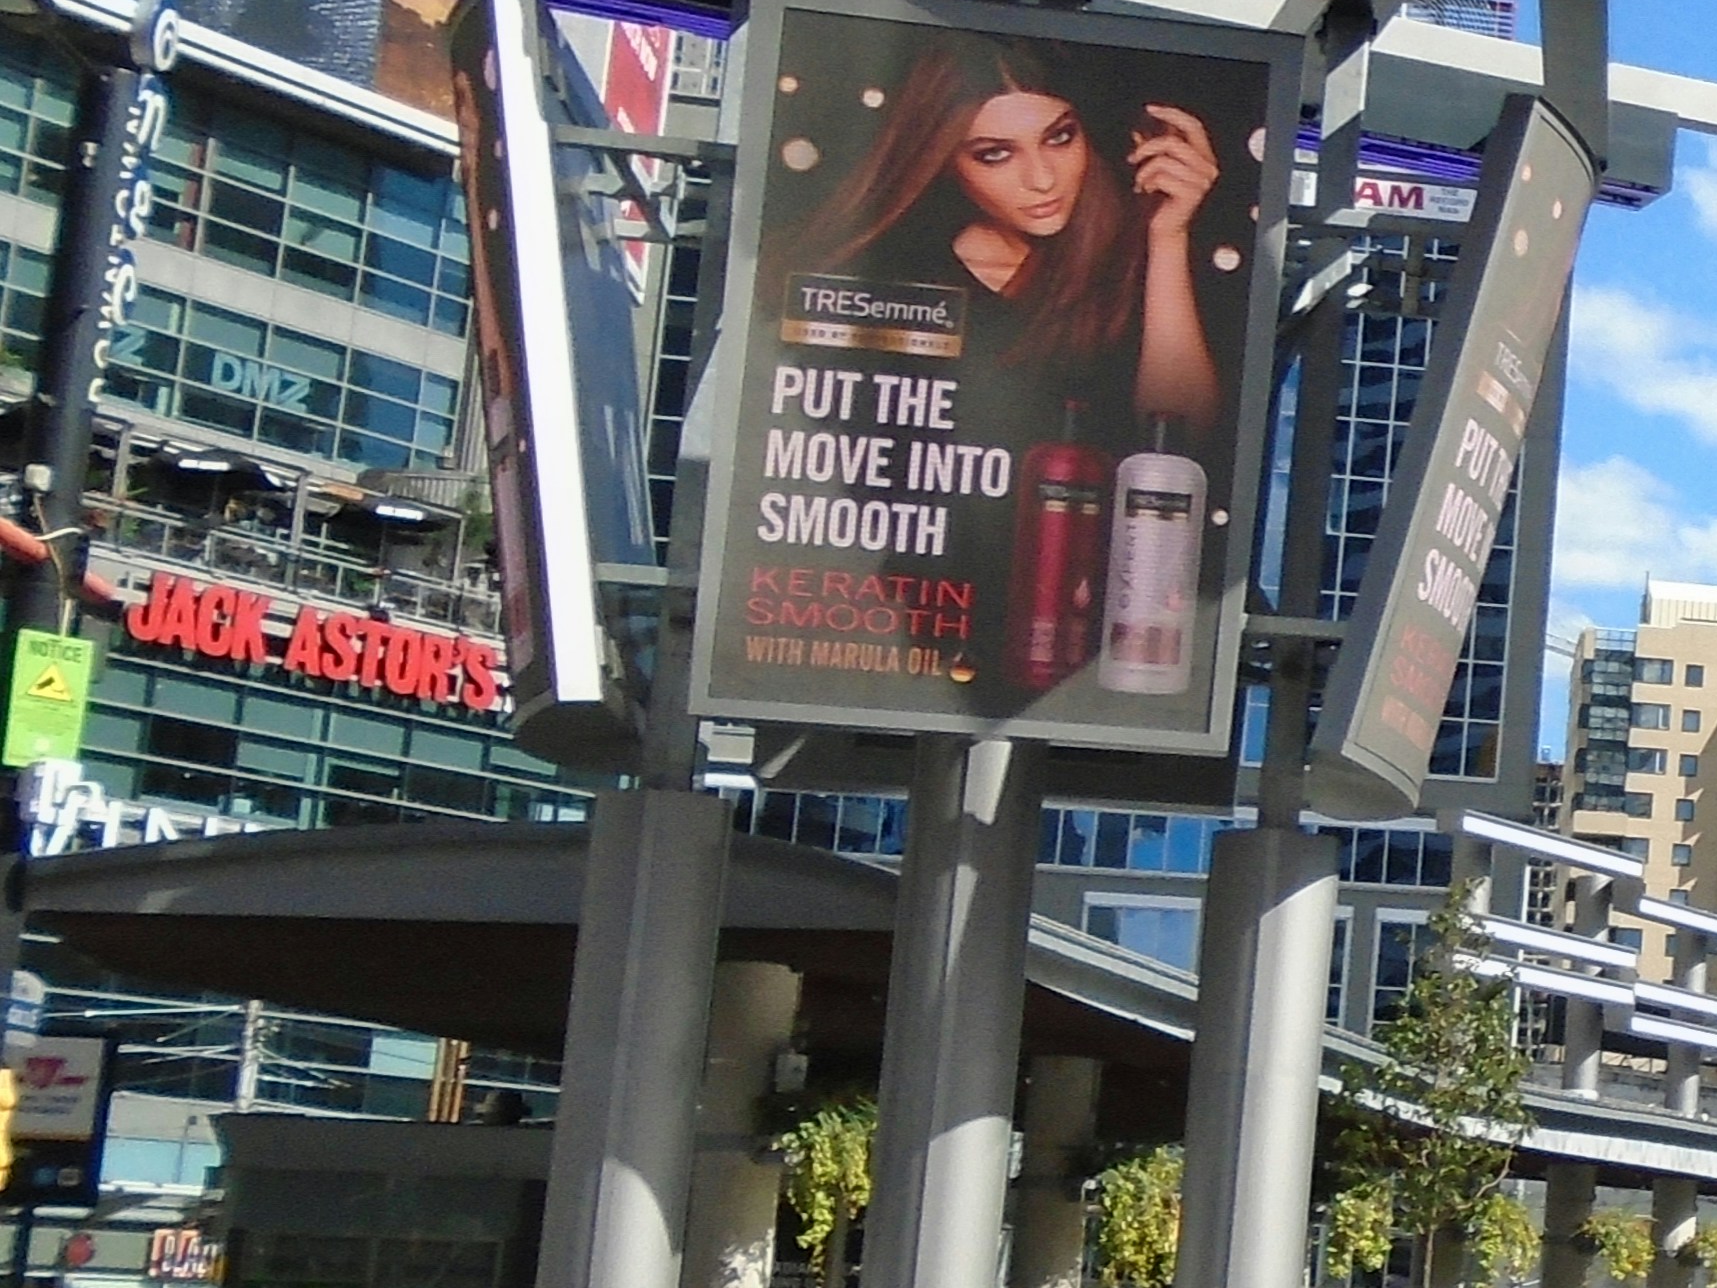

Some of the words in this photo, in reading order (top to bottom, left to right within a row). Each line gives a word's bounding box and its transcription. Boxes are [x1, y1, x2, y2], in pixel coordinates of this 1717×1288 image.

[801, 286, 947, 325] TRESemmé
[211, 353, 310, 411] DMZ
[771, 365, 863, 421] PUT
[873, 373, 958, 430] THE
[764, 429, 895, 489] MOVE
[907, 441, 1013, 498] INTO
[1456, 417, 1499, 487] PUT
[757, 492, 949, 556] SMOOTH
[1435, 482, 1490, 562] MOVE
[751, 566, 976, 609] KERATIN
[127, 571, 275, 665] JACK
[284, 605, 499, 711] ASTOR'S
[746, 597, 971, 640] SMOOTH
[28, 638, 83, 663] NOTICE
[746, 635, 804, 666] WITH
[810, 640, 900, 673] MARULA
[906, 646, 943, 677] OIL
